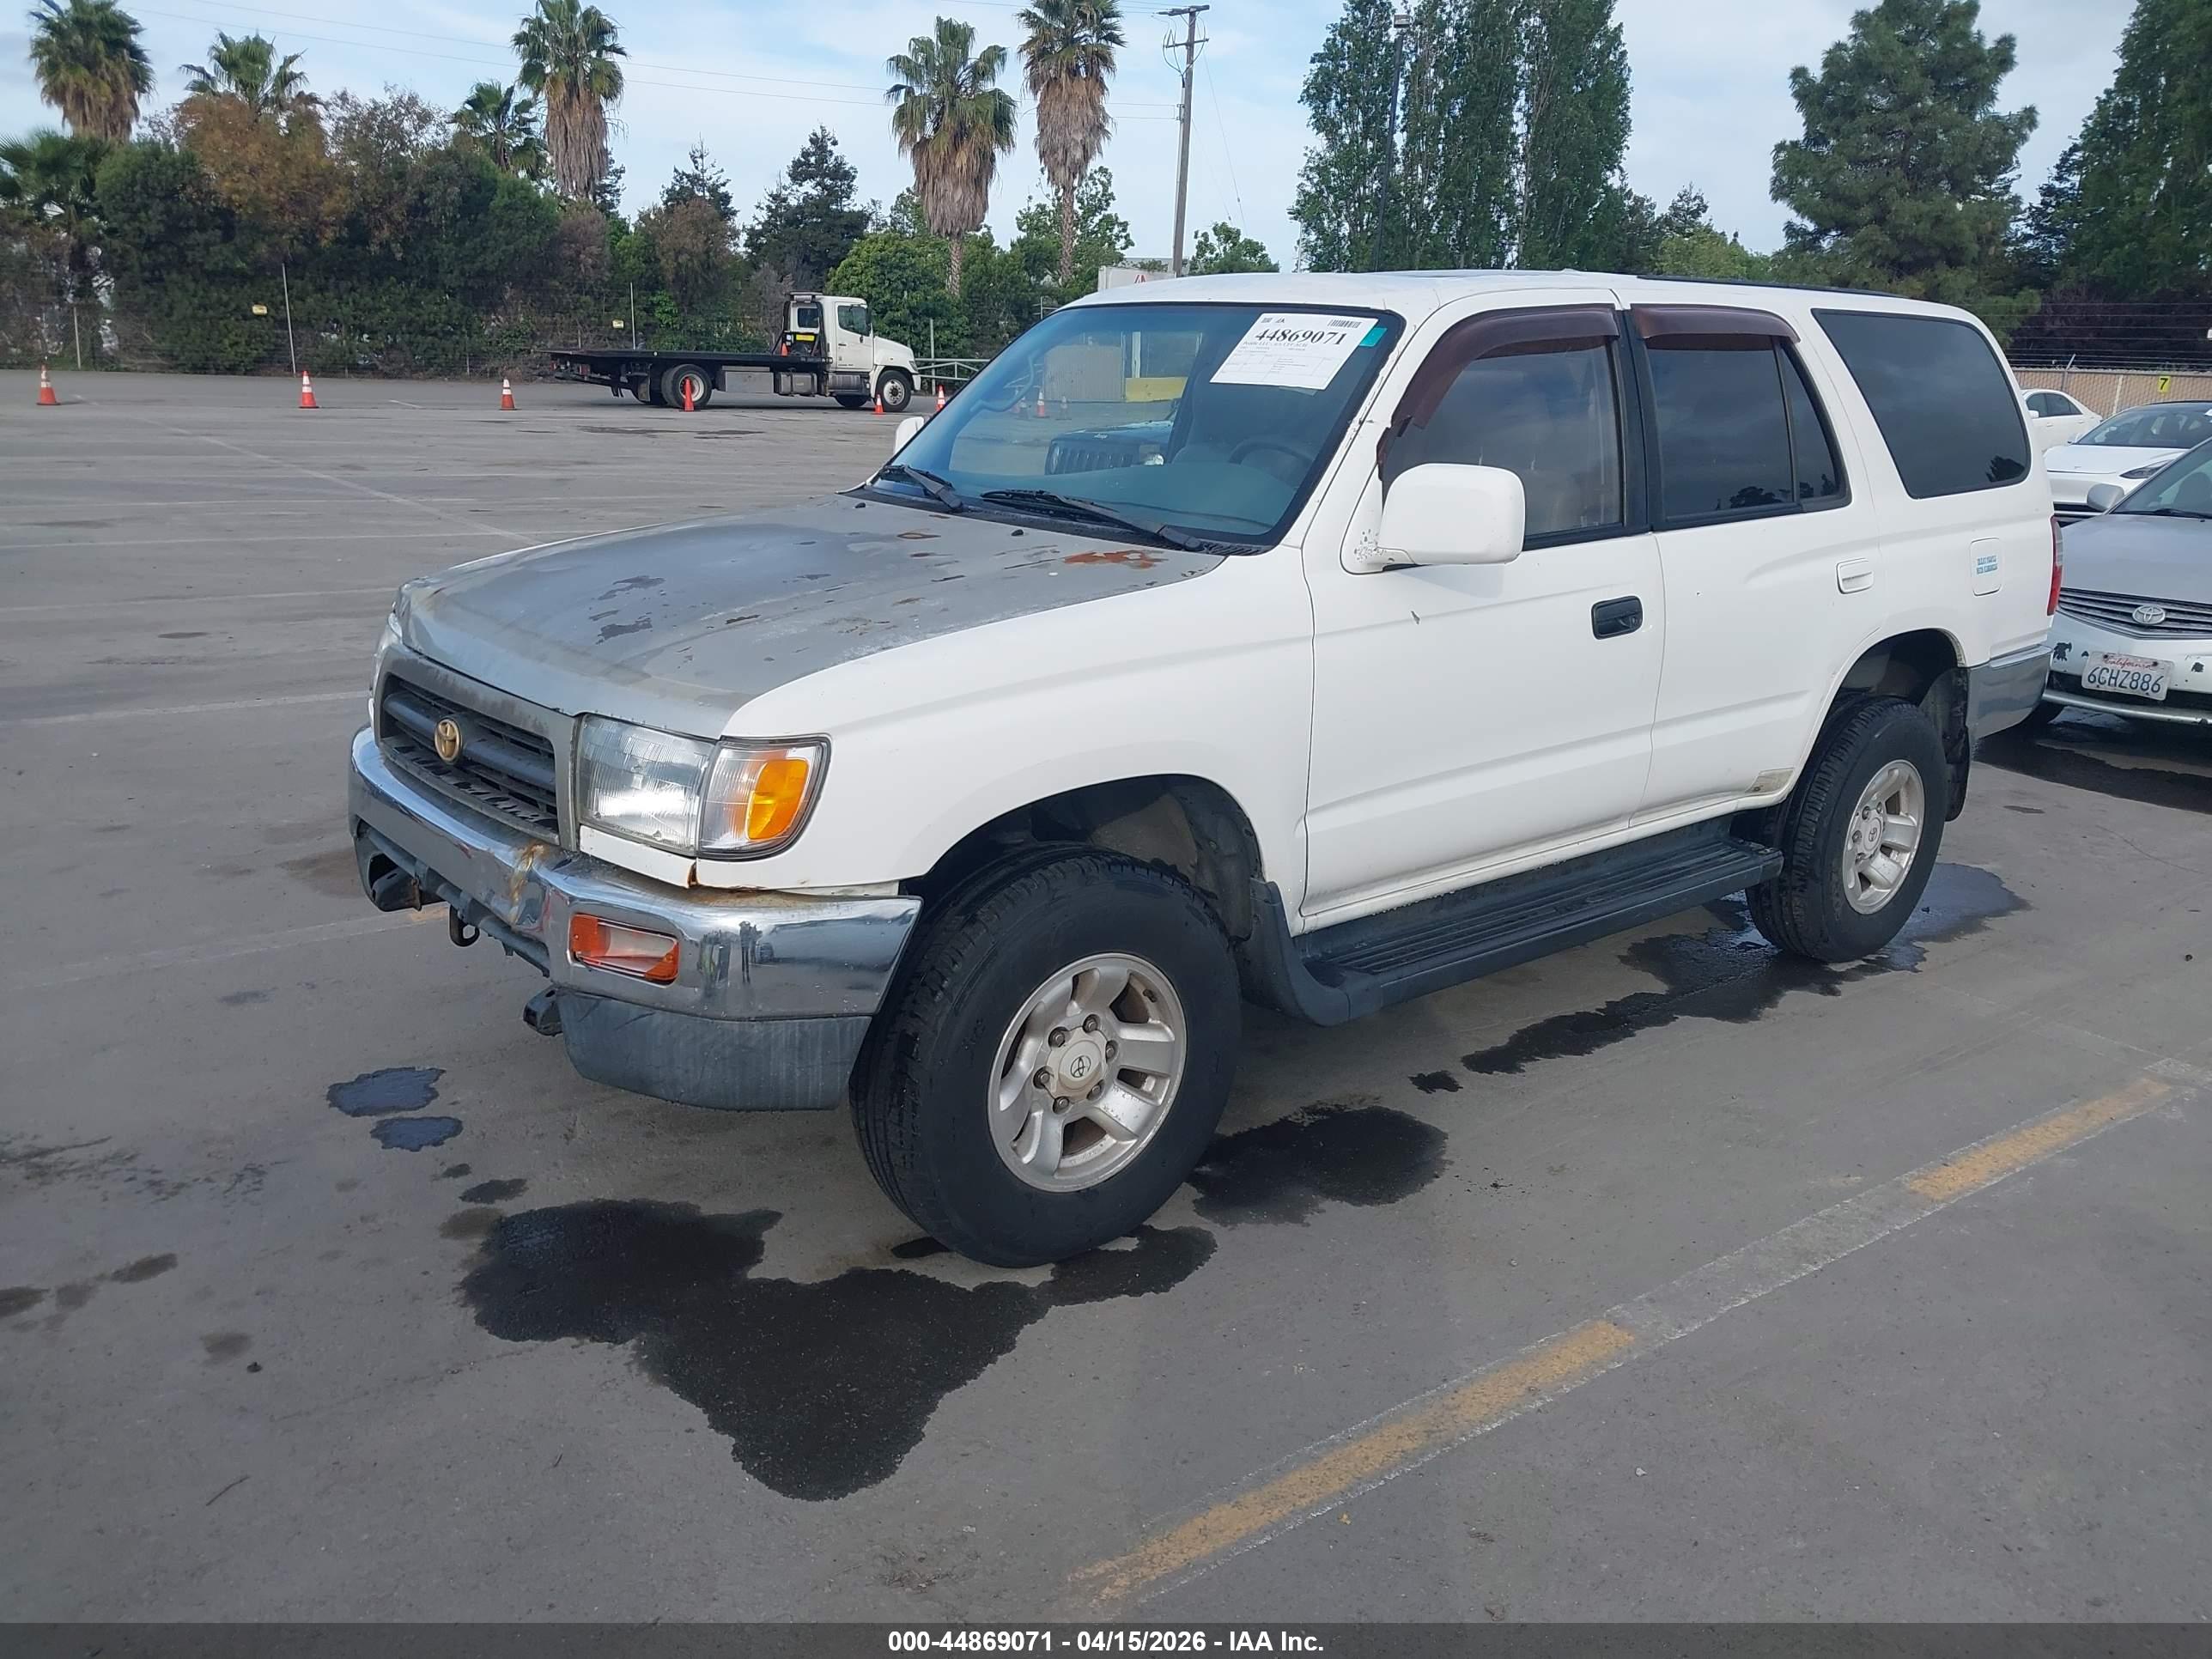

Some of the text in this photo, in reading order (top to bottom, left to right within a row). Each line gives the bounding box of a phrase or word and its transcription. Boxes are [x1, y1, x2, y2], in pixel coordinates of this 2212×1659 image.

[1255, 328, 1347, 345] 44869071
[2160, 377, 2169, 391] 7
[2103, 657, 2154, 671] California
[2087, 666, 2164, 693] 6CHZ886
